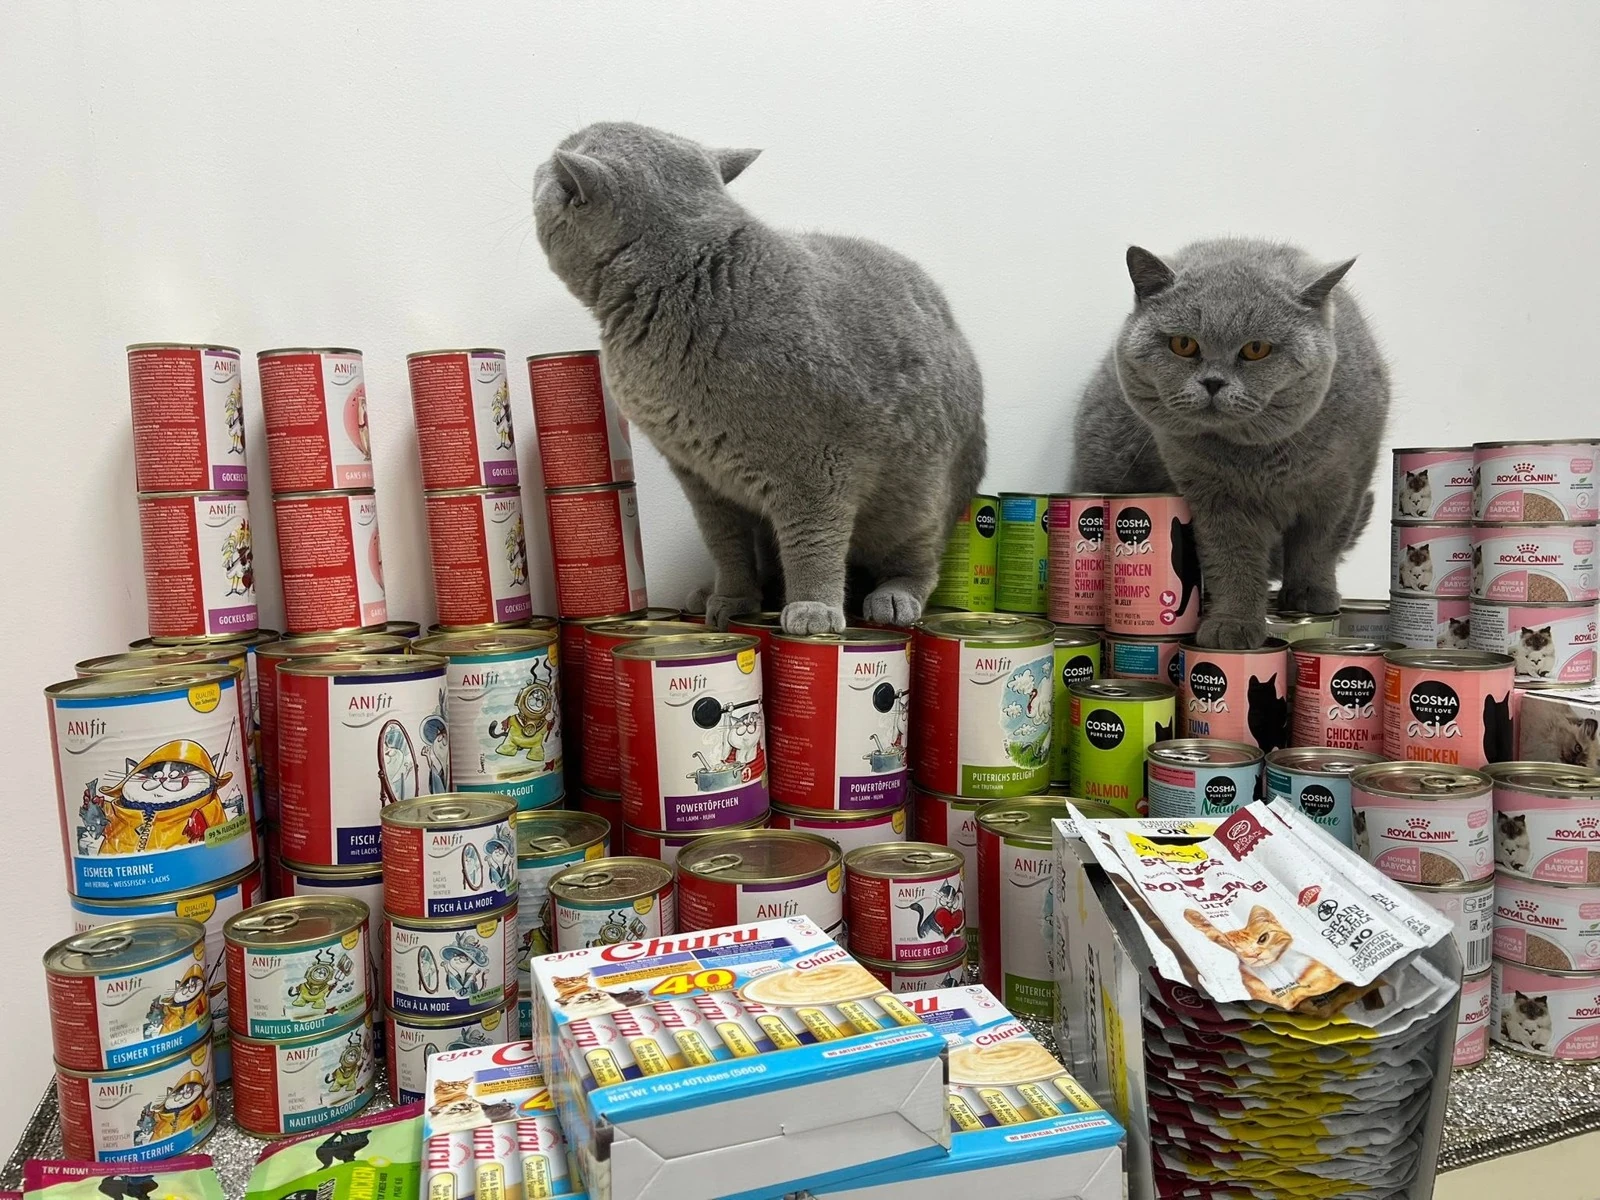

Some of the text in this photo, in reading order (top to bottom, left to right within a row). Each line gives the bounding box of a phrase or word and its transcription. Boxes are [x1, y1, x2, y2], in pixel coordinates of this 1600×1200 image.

[214, 360, 237, 373] ANIfit
[480, 361, 500, 373] ANIfit
[222, 472, 241, 482] GOCKELS
[345, 471, 361, 480] GANS
[492, 468, 511, 477] GOCKELS
[1497, 475, 1521, 483] ROYAL
[209, 504, 236, 515] ANIfit
[494, 501, 515, 512] ANIfit
[1117, 519, 1150, 528] COSMA
[1115, 536, 1154, 557] asia
[1500, 555, 1527, 563] ROYAL
[1115, 564, 1151, 576] CHICKEN
[1115, 585, 1150, 597] SHRIMPS
[505, 604, 525, 614] GOCKELS
[219, 615, 245, 625] GOCKELS
[855, 661, 888, 677] ANIfit
[976, 657, 1012, 672] ANIfit
[1064, 666, 1093, 676] COSMA
[462, 671, 500, 687] ANIfit
[669, 675, 707, 692] ANIfit
[1191, 673, 1225, 685] COSMA
[1332, 679, 1374, 689] COSMA
[348, 693, 393, 711] ANIfit
[1188, 693, 1229, 713] asia
[1411, 694, 1458, 707] COSMA
[1328, 698, 1377, 720] asia
[68, 718, 107, 735] ANIfit
[1086, 721, 1123, 732] COSMA
[1189, 719, 1209, 735] TUNA
[1407, 716, 1462, 739] asia
[1327, 728, 1368, 740] CHICKEN
[1407, 745, 1458, 765] CHICKEN
[973, 770, 1035, 781] PUTERICHS DELIGHT
[507, 785, 533, 797] RAGOUT
[851, 778, 900, 792] POWERTÖPFCHEN
[1085, 782, 1128, 799] SALMON
[1206, 785, 1235, 793] COSMA
[1301, 793, 1333, 803] COSMA
[676, 797, 739, 813] POWERTÖPFCHEN
[350, 835, 374, 845] FISCH
[432, 834, 463, 846] ANIfit
[1387, 828, 1417, 839] ROYAL
[1555, 830, 1586, 839] ROYAL
[83, 864, 154, 877] EISMEER TERRINE
[1015, 859, 1053, 875] ANIfit
[1380, 861, 1416, 872] BABYCAT
[1545, 864, 1583, 873] BABYCAT
[114, 879, 146, 888] WEISSFISCH
[151, 875, 170, 885] LACHS
[898, 886, 925, 899] ANIfit
[433, 896, 493, 913] FISCH À LA MODE
[757, 901, 798, 918] ANIfit
[560, 909, 580, 921] ANIfit
[1498, 906, 1525, 921] ROYAL
[1322, 905, 1360, 937] GRAIN
[1328, 910, 1370, 945] FREE
[1334, 916, 1374, 948] FORMULA
[396, 932, 420, 946] ANIfit
[544, 928, 759, 962] CIAO Churu
[1349, 929, 1373, 951] NO
[899, 944, 949, 958] DELICE DE CŒUR
[1352, 932, 1393, 965] ARTIFICIAL
[1591, 945, 1598, 954] 2
[252, 955, 281, 968] ANIfit
[795, 948, 847, 970] Churu
[1359, 942, 1404, 971] COLOURINGS
[107, 976, 143, 994] ANIfit
[649, 969, 735, 996] 40
[704, 983, 734, 993] Tubes
[900, 982, 927, 991] ANIfit
[1015, 984, 1055, 998] PUTERICHS
[396, 1000, 450, 1012] FISCH À LA MODE
[110, 1027, 140, 1039] WEISSFISCH
[255, 1019, 326, 1035] NAUTILUS RAGOUT
[400, 1030, 424, 1043] ANIfit
[976, 1025, 1025, 1045] Churu
[113, 1036, 184, 1064] EISMEER TERRINE
[839, 1032, 928, 1056] ARTIFICIAL PRESERVATIVES
[1566, 1042, 1598, 1050] BABYCAT
[286, 1048, 319, 1062] ANIfit
[437, 1049, 482, 1062] CIAO
[99, 1082, 134, 1097] ANIfit
[608, 1064, 766, 1103] Net Wt (560g)
[1073, 1095, 1089, 1109] Recipe
[289, 1099, 357, 1128] NAUTILUS RAGOUT
[1020, 1128, 1053, 1141] ARTIFICIAL
[1055, 1120, 1107, 1135] PRESERVATIVES
[104, 1142, 174, 1163] EISMEER TERRINE
[42, 1166, 59, 1174] TRY
